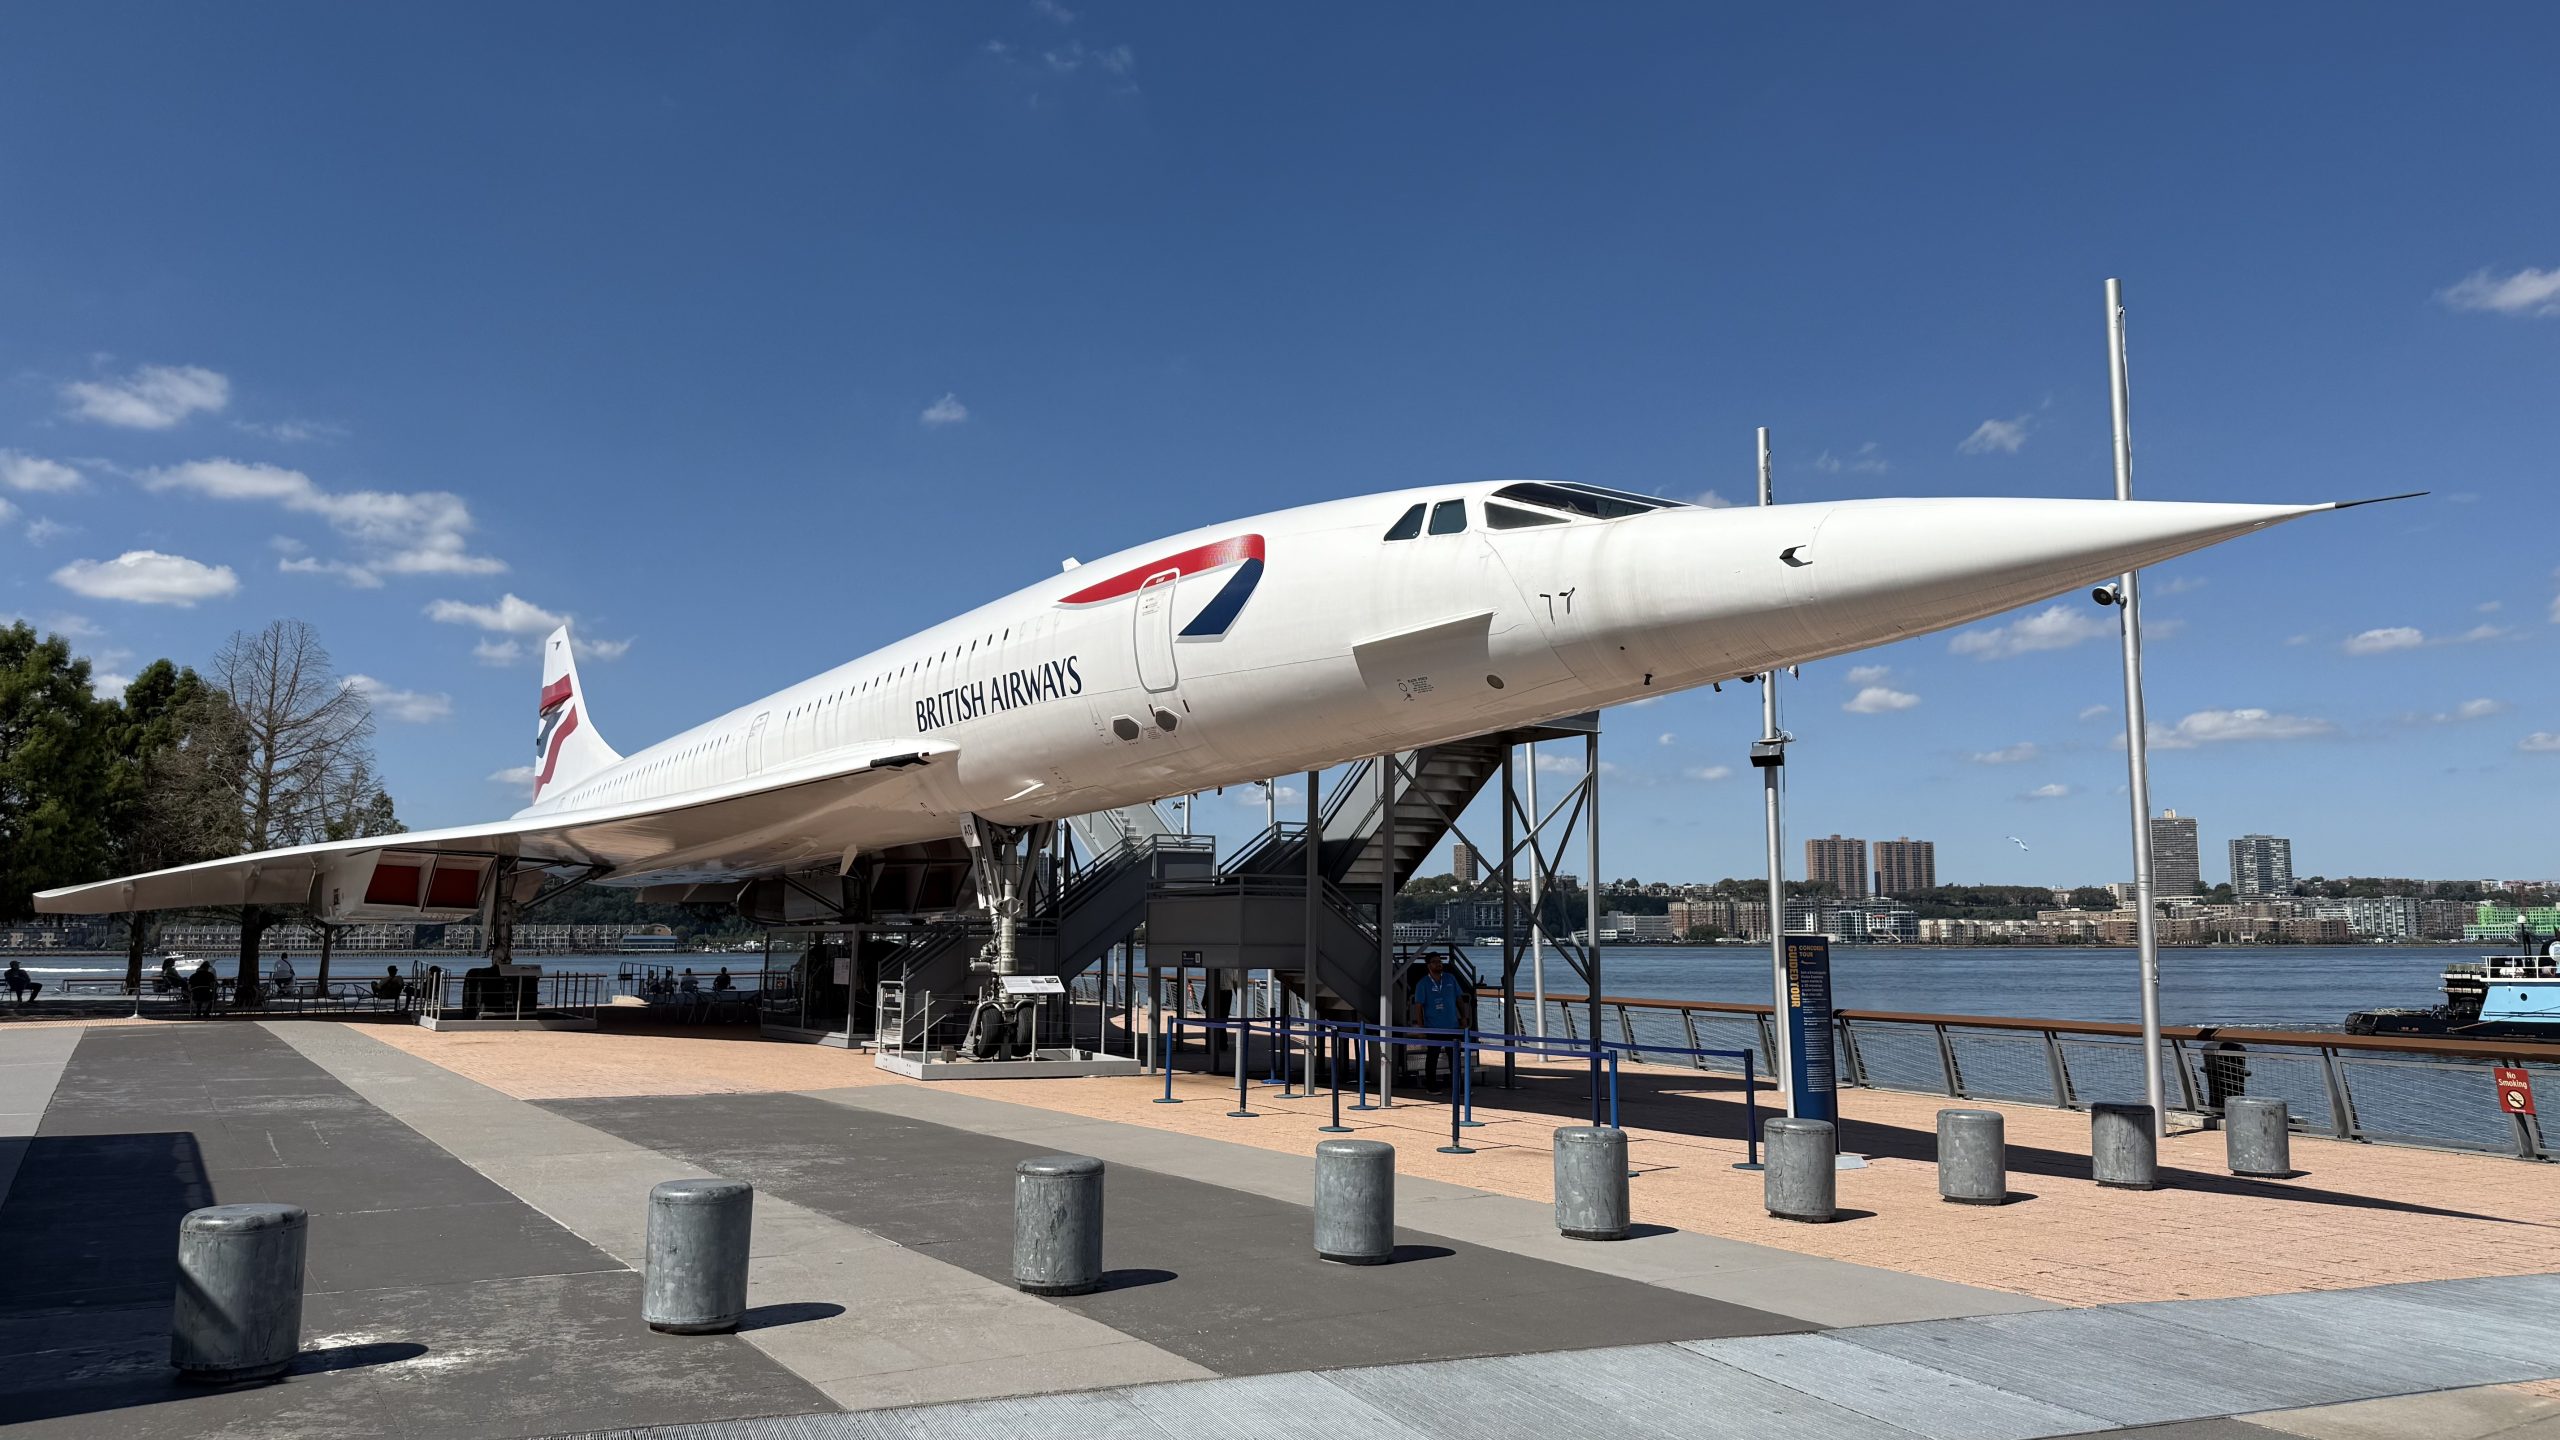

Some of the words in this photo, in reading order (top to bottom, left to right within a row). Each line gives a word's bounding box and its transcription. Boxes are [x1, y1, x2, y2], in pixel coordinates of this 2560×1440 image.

[916, 681, 987, 733] BRITISH
[991, 655, 1082, 714] AIRWAYS
[963, 824, 973, 836] AD
[1788, 945, 1798, 980] GUIDED
[1790, 981, 1801, 1008] TOUR
[2498, 1079, 2528, 1089] Smoking
[2506, 1071, 2516, 1079] No
